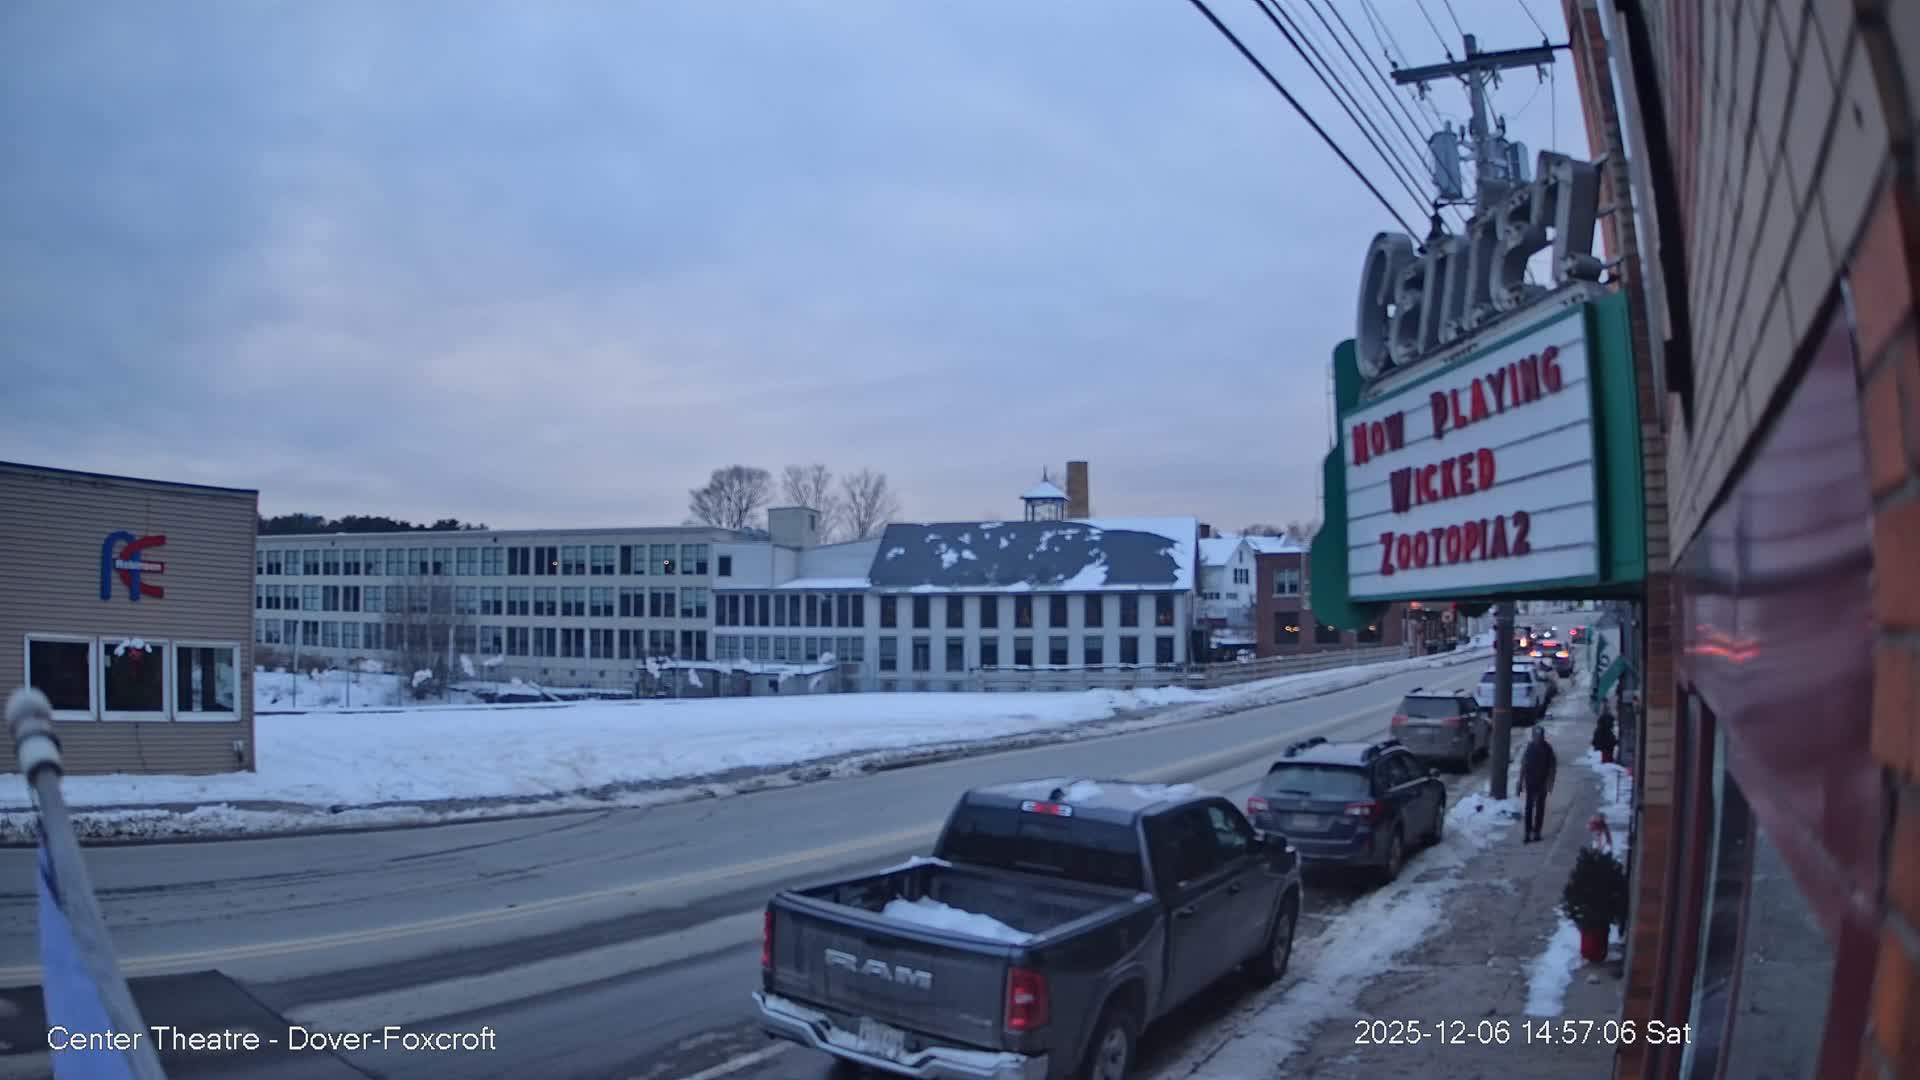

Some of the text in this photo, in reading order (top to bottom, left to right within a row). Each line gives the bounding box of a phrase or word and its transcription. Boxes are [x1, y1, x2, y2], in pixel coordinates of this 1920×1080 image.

[1352, 345, 1562, 466] NOW PLAYING
[1390, 448, 1496, 513] WICKED
[1380, 511, 1531, 576] ZOOTOPIA2
[824, 948, 934, 989] RAM
